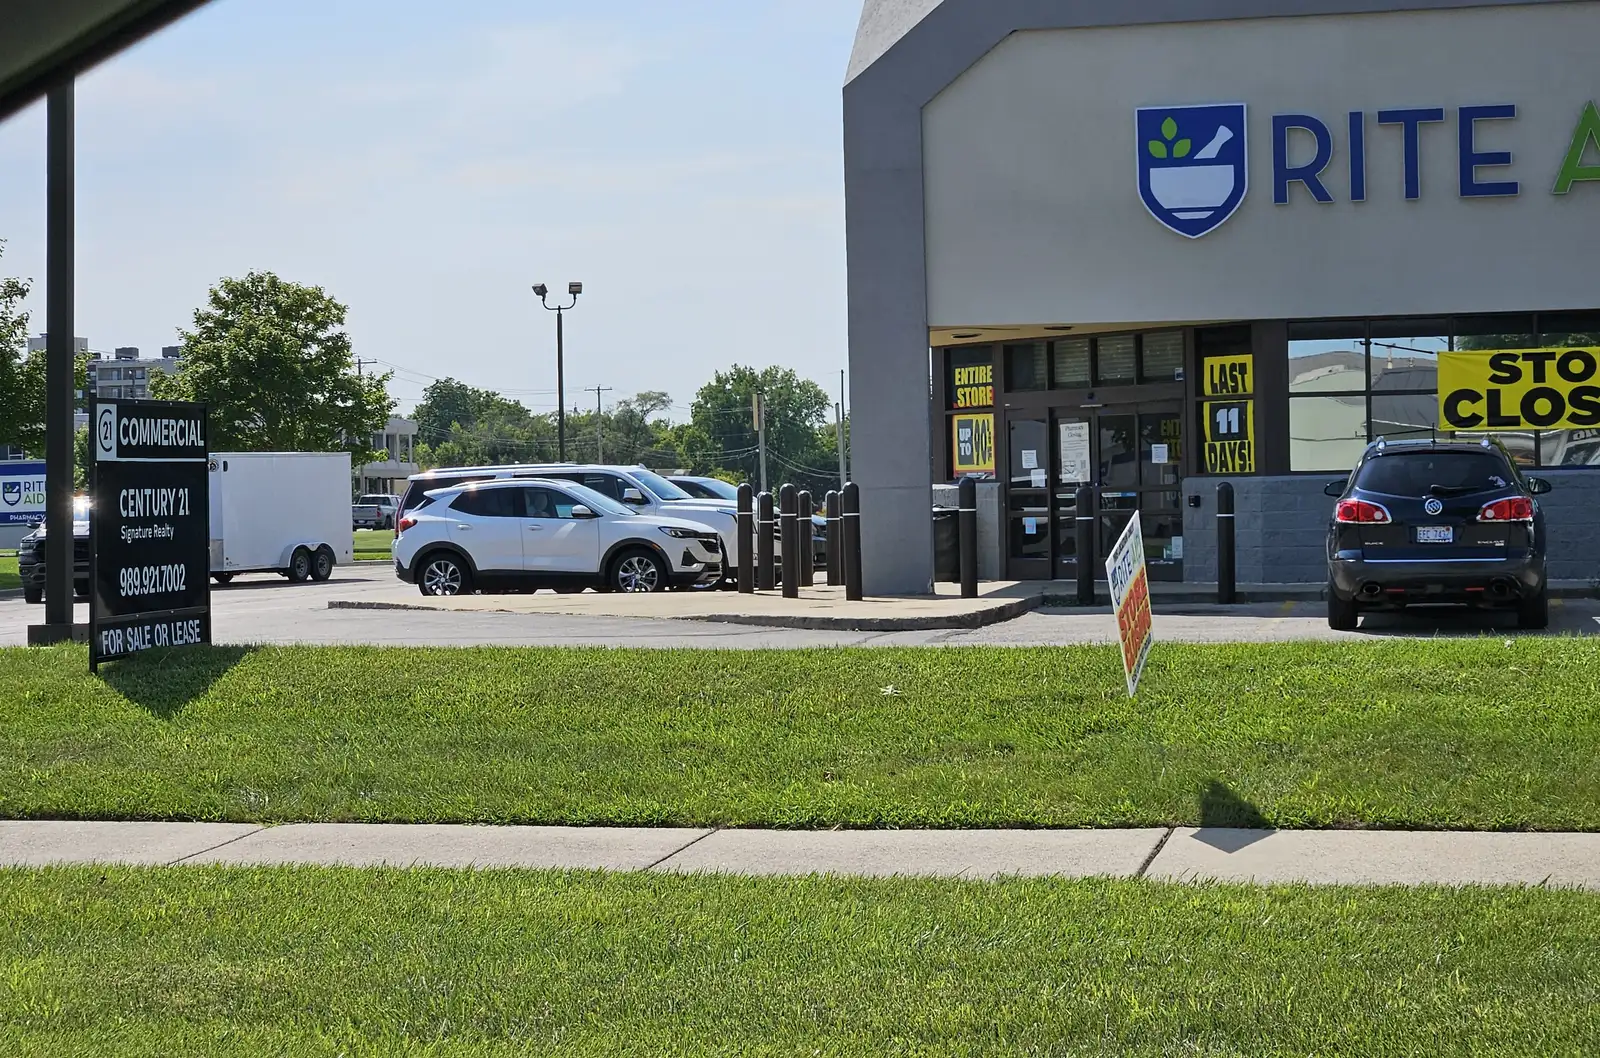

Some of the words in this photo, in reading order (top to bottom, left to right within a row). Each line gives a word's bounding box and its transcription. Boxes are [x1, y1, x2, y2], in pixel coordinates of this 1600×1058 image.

[1271, 104, 1520, 204] RITE
[954, 365, 993, 386] ENTIRE
[1210, 362, 1248, 394] LAST
[1488, 350, 1597, 385] STO
[957, 385, 994, 408] STORE
[1443, 385, 1600, 428] CLOS
[120, 417, 205, 446] COMMERCIAL
[959, 428, 972, 441] UP
[1216, 408, 1239, 433] 11
[960, 443, 972, 456] TO
[1207, 440, 1252, 472] DAYS!
[23, 481, 47, 492] RIT
[23, 493, 46, 504] AID
[120, 488, 176, 517] CENTURY
[178, 487, 190, 516] 21
[10, 513, 45, 522] PHARMACY
[120, 525, 153, 544] Signature
[153, 523, 175, 540] Realty
[120, 563, 186, 597] 989.921.7002
[1117, 550, 1133, 590] RITE
[102, 629, 124, 655] FOR
[126, 625, 152, 652] SALE
[154, 623, 169, 647] OR
[171, 619, 201, 645] LEASE
